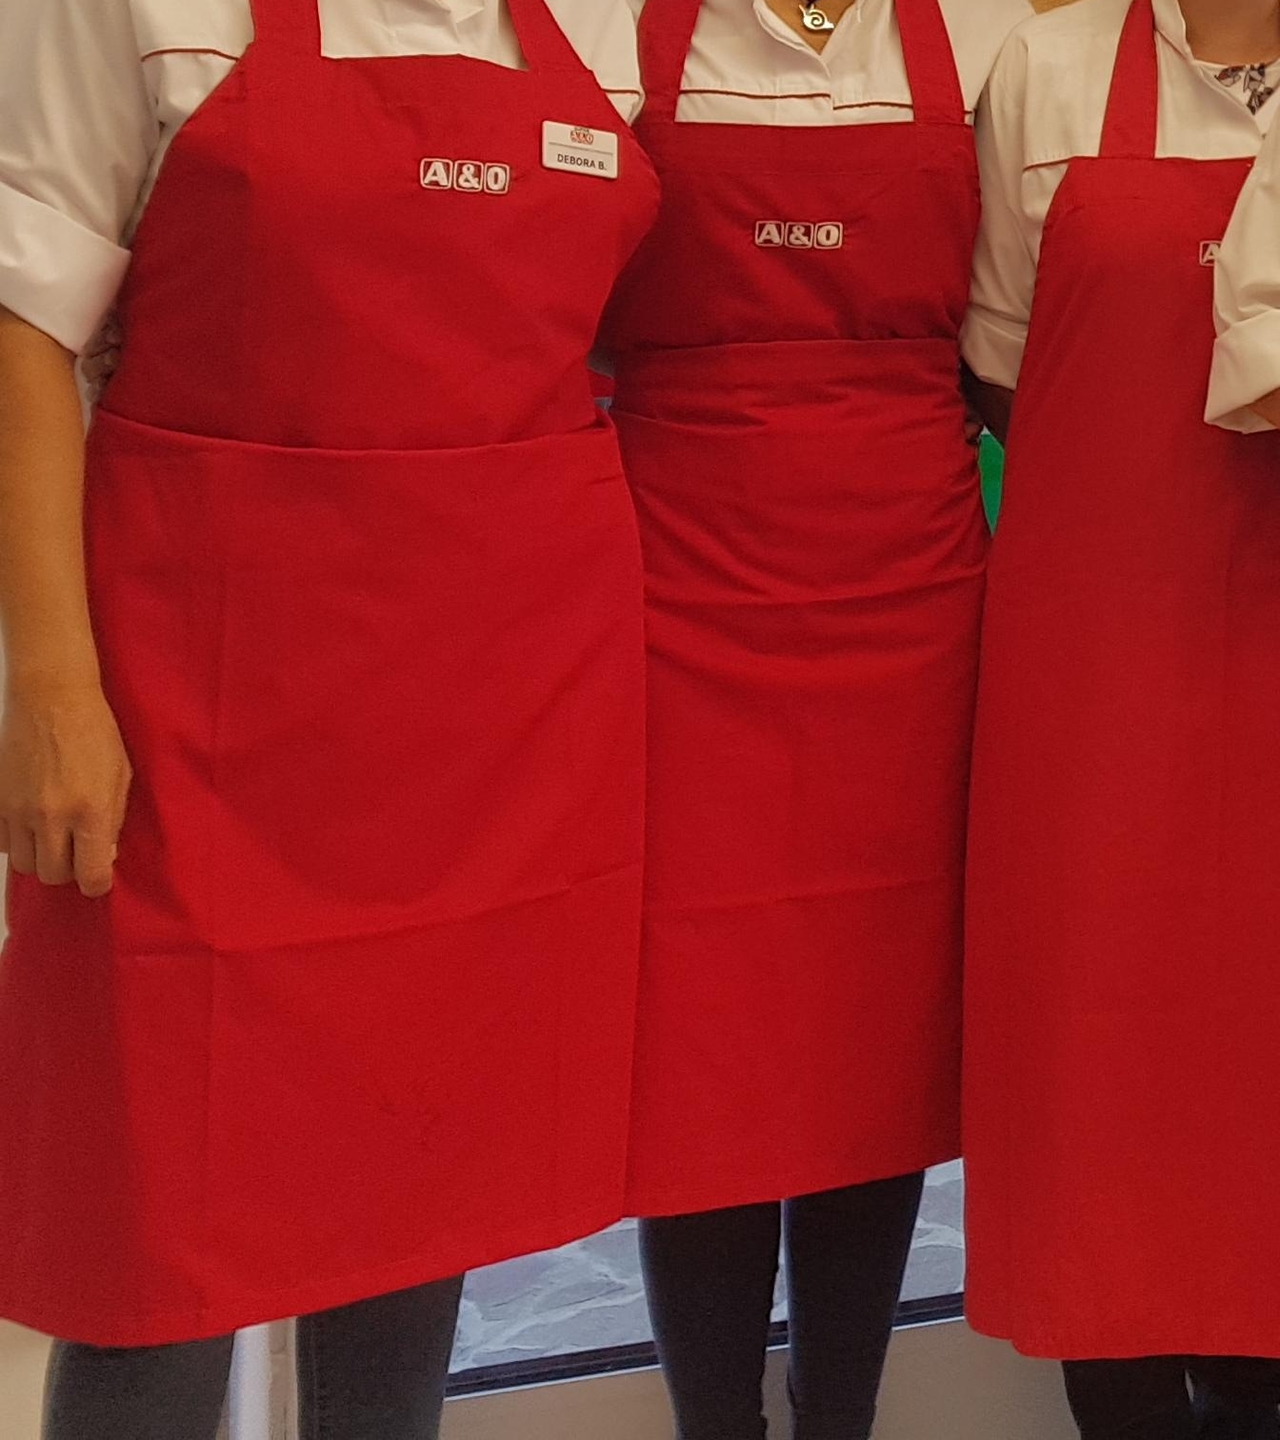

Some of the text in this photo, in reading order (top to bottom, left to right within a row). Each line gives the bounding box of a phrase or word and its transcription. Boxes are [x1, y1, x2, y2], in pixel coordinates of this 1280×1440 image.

[557, 153, 596, 168] DEBORA
[423, 160, 507, 192] A&O
[757, 223, 840, 247] A&O
